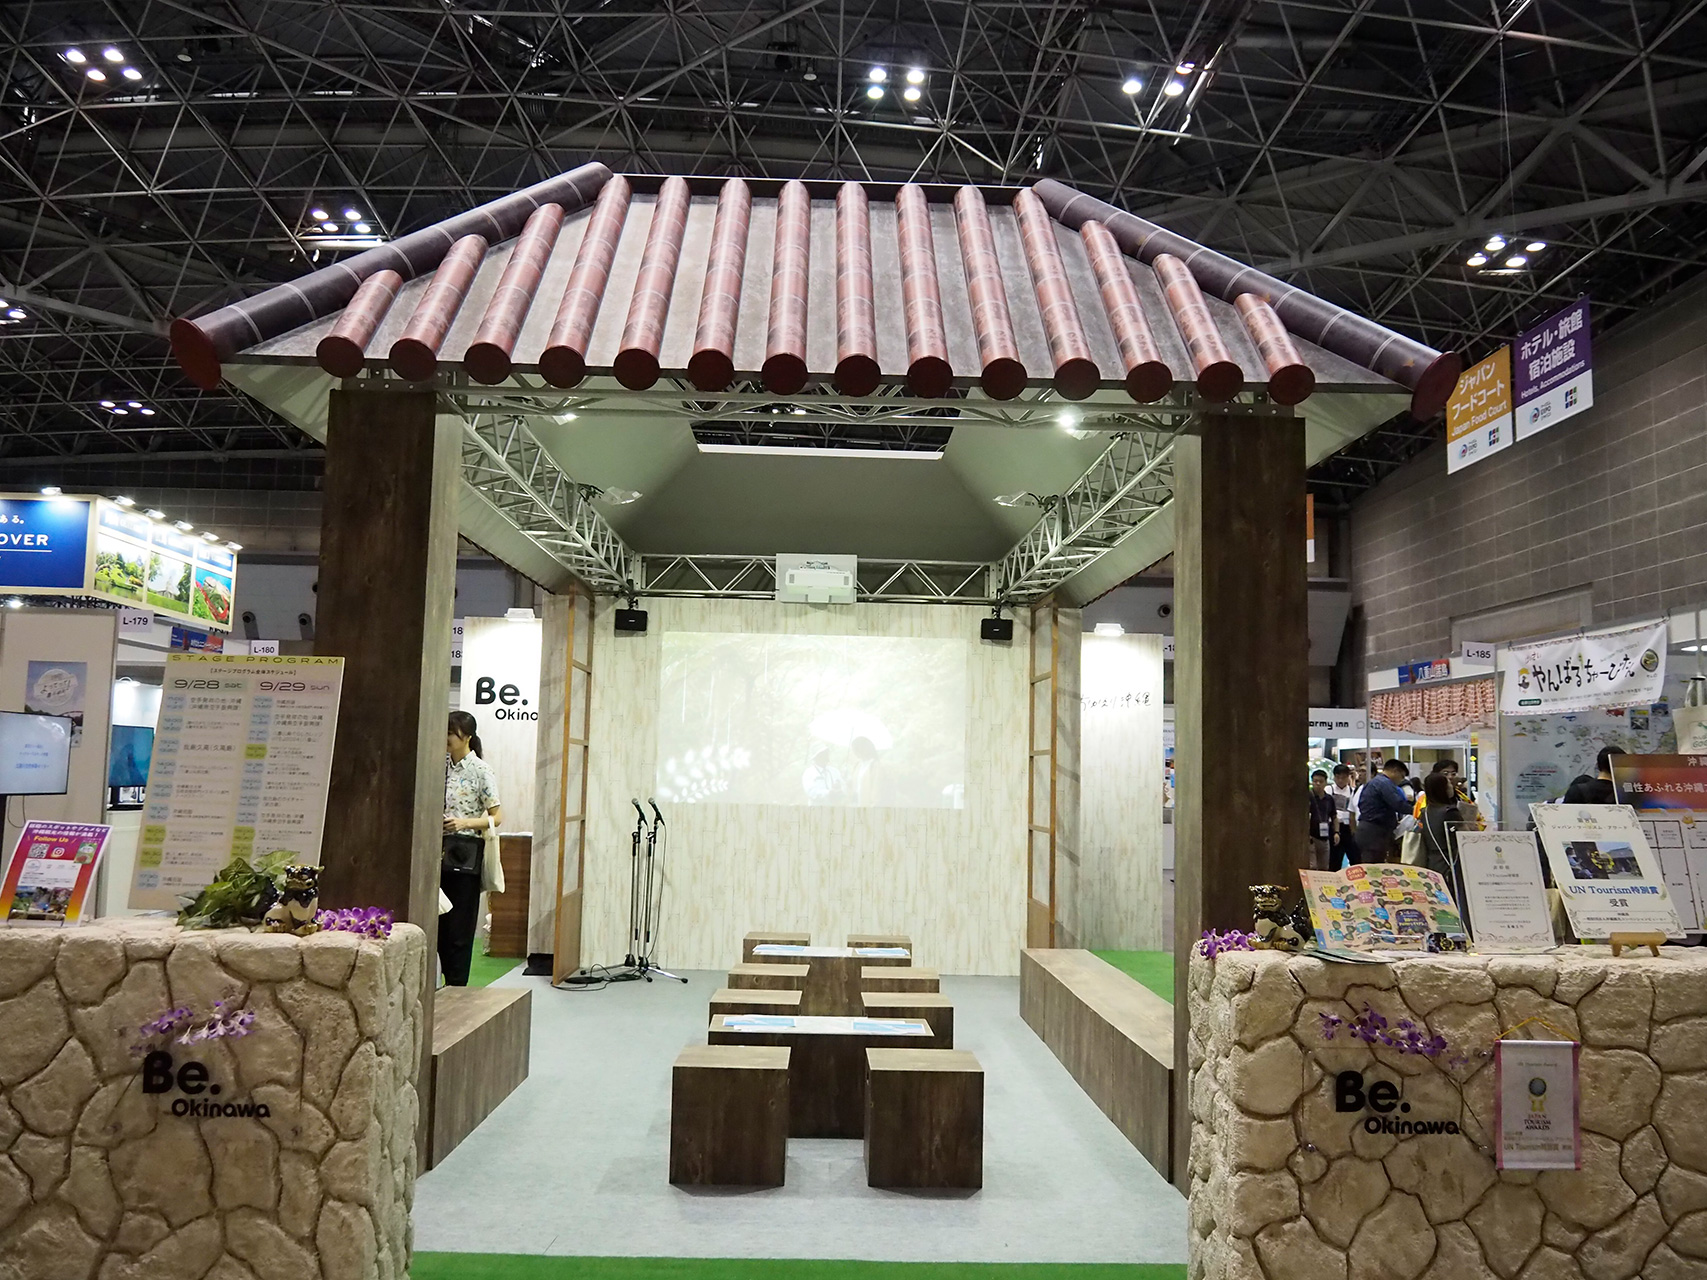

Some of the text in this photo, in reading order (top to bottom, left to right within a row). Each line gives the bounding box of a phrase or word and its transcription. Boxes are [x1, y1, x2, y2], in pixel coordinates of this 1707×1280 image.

[1521, 308, 1583, 360] ホテル・旅館
[1528, 338, 1576, 381] 宿泊施設
[1459, 361, 1496, 395] ジャパン
[1452, 379, 1505, 420] フードコート
[1451, 399, 1508, 437] Japan Food Court
[122, 616, 149, 626] L-179
[253, 646, 275, 654] L-180
[451, 650, 462, 659] 18
[1466, 650, 1491, 659] L-185
[172, 654, 339, 665] STAGE PROGRAM
[174, 679, 220, 689] 9/28
[260, 681, 306, 692] 9/29
[475, 676, 529, 706] Be.
[33, 835, 69, 844] Follow Us
[1568, 885, 1660, 895] UN Tourism特別賞
[1609, 898, 1629, 908] 受賞
[142, 1050, 221, 1095] Be.
[1336, 1070, 1411, 1114] Be.
[171, 1097, 271, 1118] Okinawa
[1364, 1115, 1460, 1135] Okinawa
